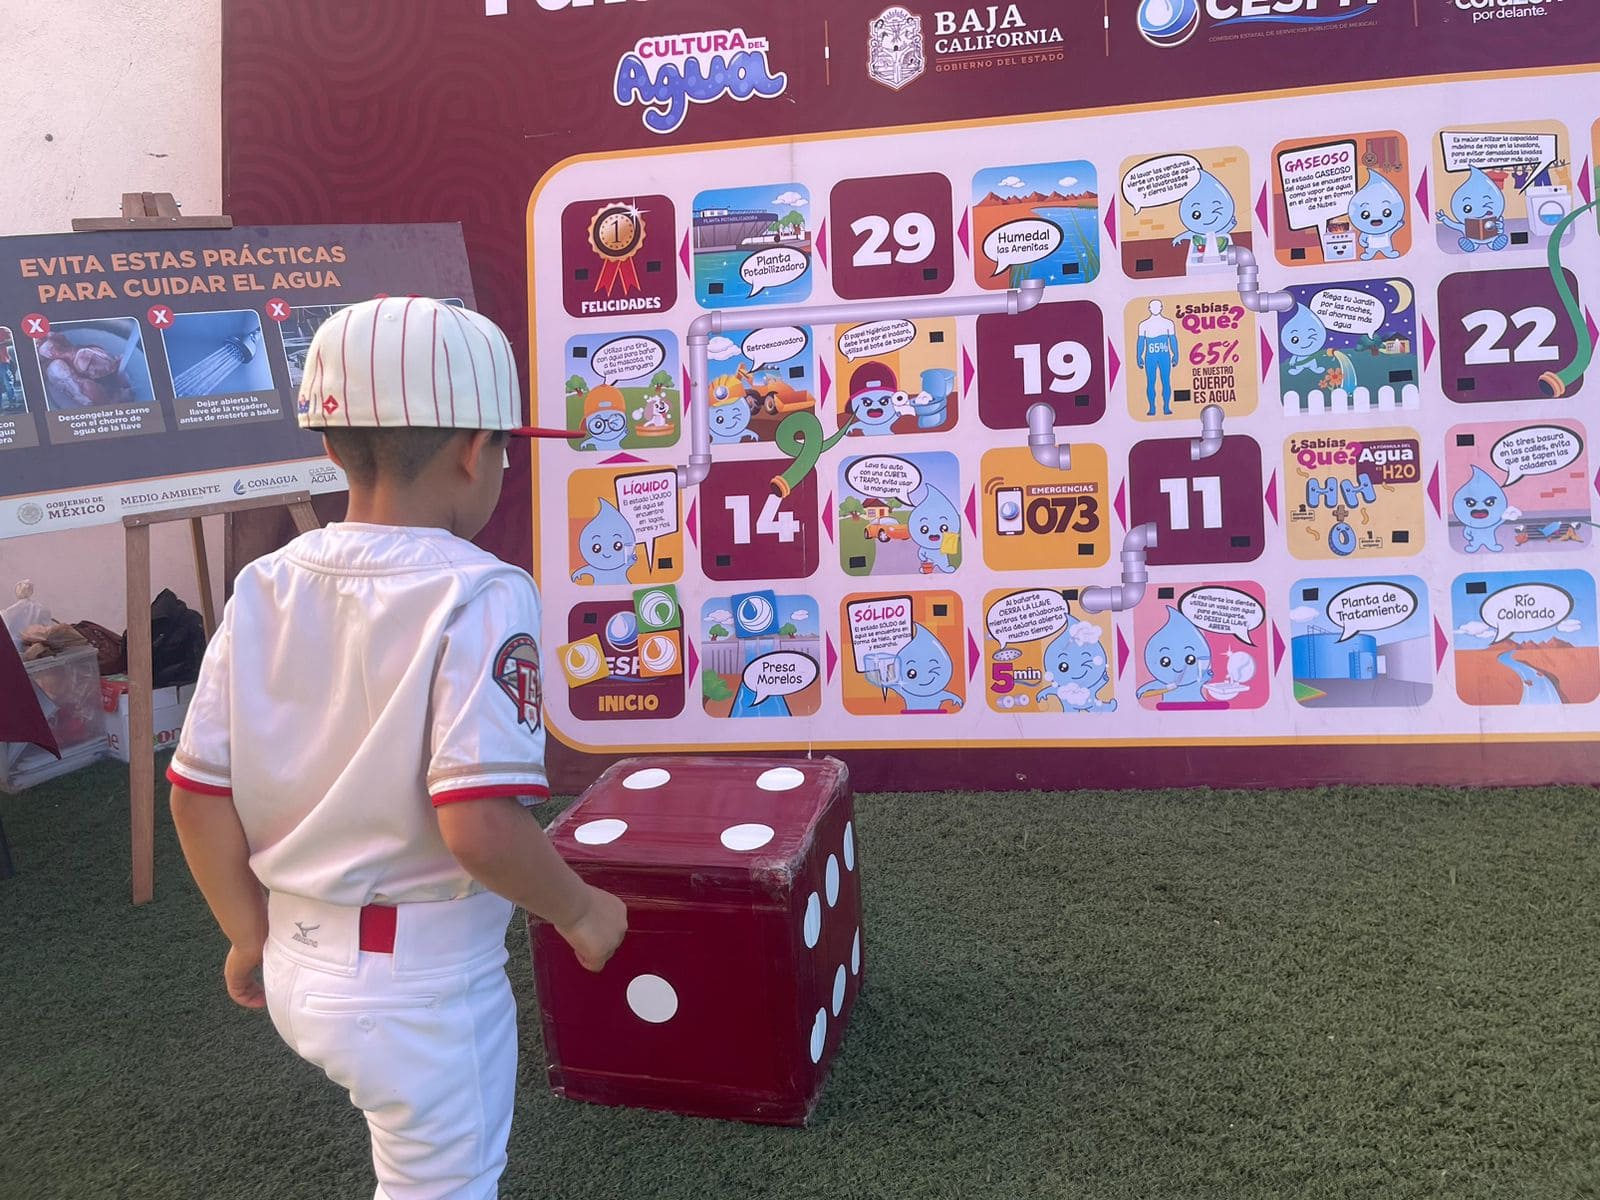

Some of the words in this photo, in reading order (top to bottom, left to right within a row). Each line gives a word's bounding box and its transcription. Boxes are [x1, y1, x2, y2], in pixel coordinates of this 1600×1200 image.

[934, 4, 1026, 35] BAJA
[1473, 11, 1495, 23] por
[1496, 5, 1547, 19] delante.
[639, 33, 745, 58] CULTURA
[935, 28, 1063, 53] CALIFORNIA
[936, 60, 992, 72] GOBIERNO
[997, 58, 1016, 66] DEL
[1022, 54, 1064, 63] ESTADO
[616, 51, 784, 131] Agua
[1285, 151, 1349, 173] GASEOSO
[611, 219, 622, 243] 1
[998, 229, 1050, 243] Humedal
[850, 212, 936, 267] 29
[997, 245, 1009, 254] las
[1011, 242, 1049, 252] Arenitas
[20, 255, 105, 278] EVITA
[111, 251, 197, 272] ESTAS
[202, 243, 346, 267] PRÁCTICAS
[756, 253, 791, 266] Planta
[744, 261, 805, 277] Potabilizadora
[38, 281, 117, 303] PARA
[124, 275, 227, 297] CUIDAR
[233, 273, 265, 291] EL
[272, 270, 341, 290] AGUA
[1322, 292, 1342, 301] Riega
[581, 297, 661, 313] FELICIDADES
[1176, 303, 1229, 318] ¿Sabías
[1346, 306, 1372, 315] noches,
[1182, 306, 1245, 334] Qué?
[1329, 311, 1356, 320] ahorras
[1333, 321, 1352, 329] agua
[1461, 306, 1560, 365] 22
[746, 336, 804, 352] Retroexcavadora
[1148, 341, 1169, 354] 65%
[1189, 340, 1239, 365] 65%
[1014, 341, 1092, 395] 19
[1193, 368, 1201, 376] DE
[1203, 366, 1233, 375] NUESTRO
[1193, 375, 1234, 390] CUERPO
[196, 400, 218, 408] Dejar
[221, 397, 248, 405] abierta
[1194, 391, 1206, 404] ES
[1209, 390, 1236, 402] AGUA
[217, 411, 248, 419] meterte
[257, 408, 279, 416] bañar
[232, 402, 268, 411] regadera
[58, 411, 113, 421] Descongelar
[73, 428, 95, 436] agua
[1291, 438, 1346, 453] ¿Sabías
[1503, 439, 1513, 448] No
[1516, 437, 1535, 446] tires
[1537, 433, 1564, 443] basura
[1511, 448, 1522, 456] las
[1524, 444, 1548, 454] calles,
[1550, 440, 1570, 449] evita
[1297, 442, 1362, 469] Qué?
[1359, 448, 1413, 465] Agua
[1505, 458, 1519, 466] que
[1532, 451, 1555, 461] tapen
[1383, 464, 1415, 479] H2O
[1520, 459, 1557, 471] coladeras
[248, 475, 298, 488] CONAGUA
[624, 480, 669, 495] LÍQUIDO
[120, 493, 158, 505] MEDIO
[161, 484, 221, 500] AMBIENTE
[1031, 484, 1094, 495] EMERGENCIAS
[46, 497, 90, 509] GOBIERNO
[1160, 477, 1222, 530] 11
[48, 503, 106, 519] MÉXICO
[1026, 496, 1099, 534] 073
[725, 494, 800, 544] 14
[1013, 594, 1040, 605] bañarte
[1342, 595, 1380, 609] Planta
[1383, 592, 1396, 602] de
[1515, 593, 1535, 607] Río
[855, 605, 904, 623] SÓLIDO
[999, 607, 1021, 617] CIERRA
[1032, 599, 1051, 609] LLAVE
[1336, 604, 1409, 622] Tratamiento
[1497, 608, 1555, 620] Colorado
[990, 616, 1018, 626] mientras
[995, 626, 1012, 634] evita
[1038, 616, 1063, 625] abierta
[1008, 631, 1029, 639] mucho
[1031, 625, 1053, 633] tiempo
[762, 662, 795, 673] Presa
[757, 674, 803, 685] Morelos
[991, 663, 1015, 694] 5
[1013, 667, 1041, 680] min
[599, 695, 659, 712] INICIO
